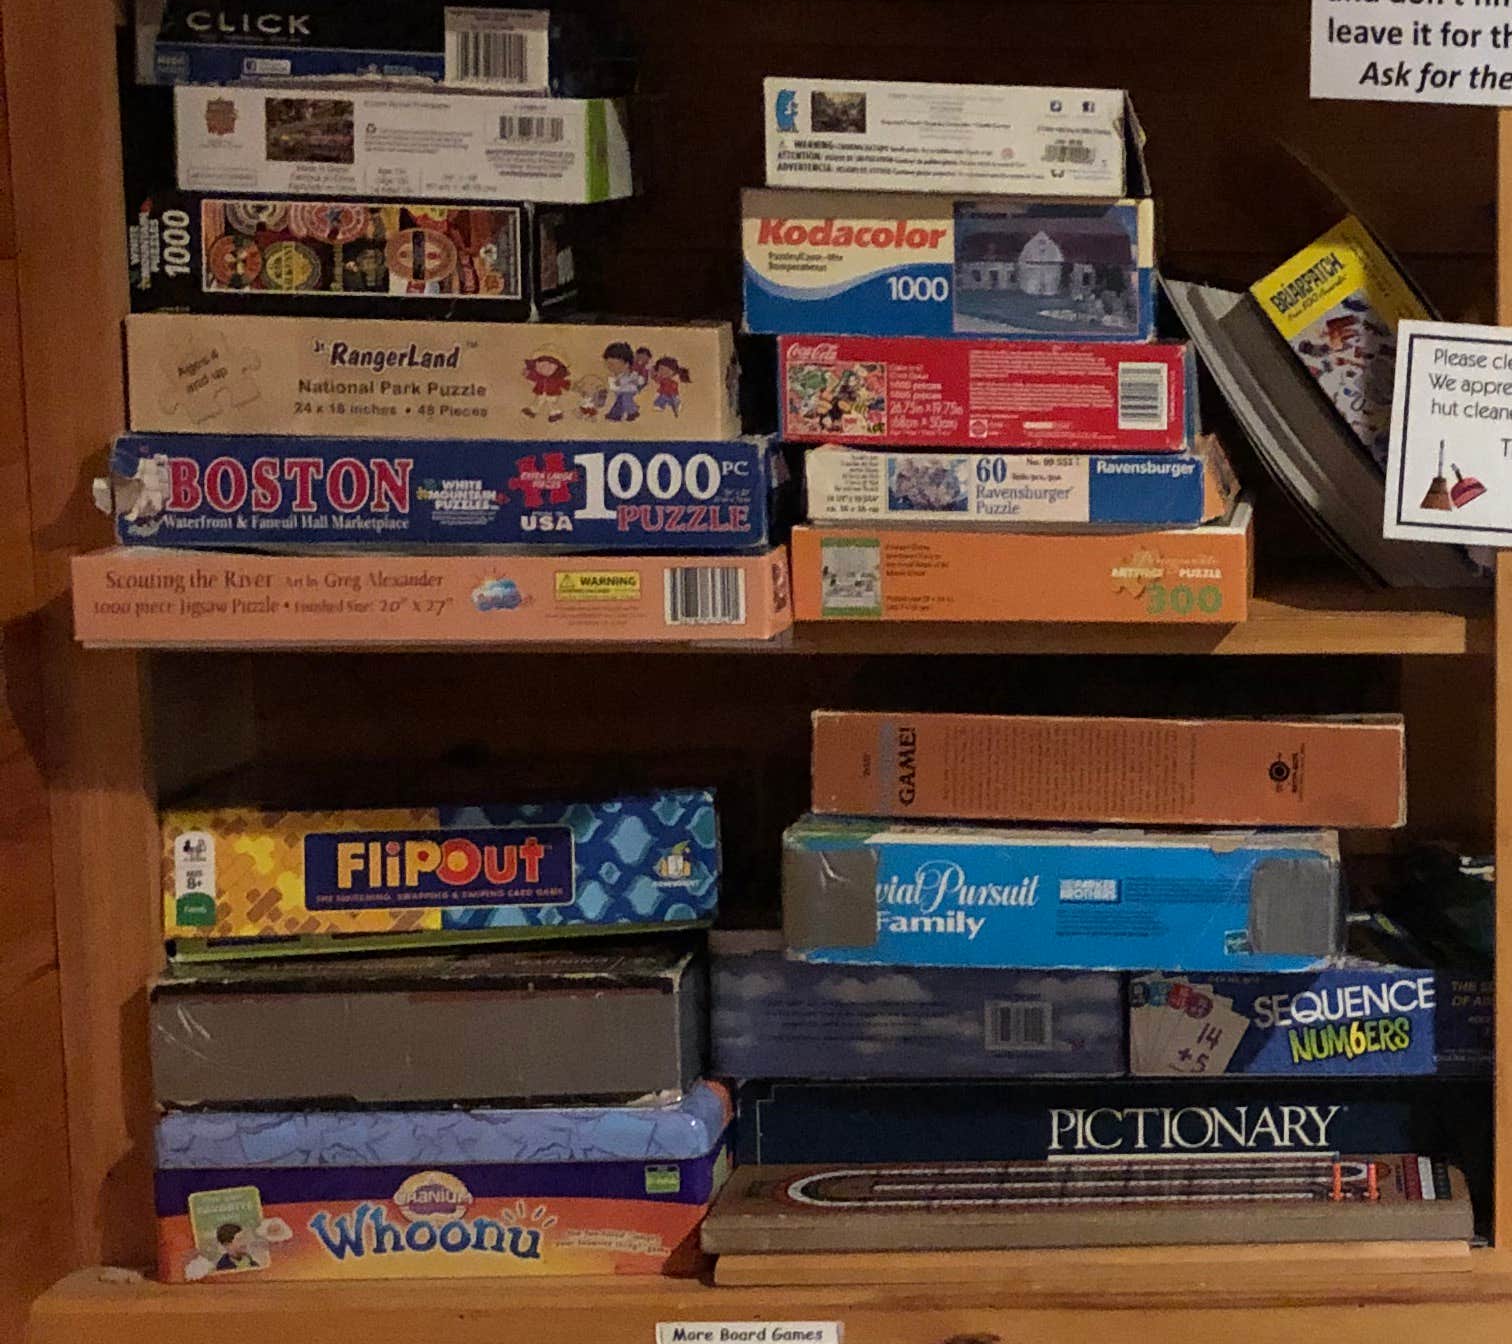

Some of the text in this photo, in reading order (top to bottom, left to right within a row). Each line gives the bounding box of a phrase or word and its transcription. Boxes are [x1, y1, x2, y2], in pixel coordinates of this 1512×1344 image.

[185, 10, 312, 35] CLICK
[1327, 19, 1404, 45] leave
[1412, 21, 1432, 46] it
[1439, 21, 1483, 47] for
[1358, 61, 1411, 87] Ask
[1414, 62, 1462, 93] for
[162, 209, 191, 277] 1000
[757, 216, 948, 250] Kodacolor
[887, 275, 949, 301] 1000
[330, 342, 462, 373] RangerLand
[1433, 348, 1488, 370] Please
[298, 379, 488, 397] National Park Puzzle
[1429, 372, 1458, 393] We
[1430, 399, 1460, 417] hut
[975, 457, 1007, 484] 60
[1096, 460, 1198, 479] Ravensburger
[166, 456, 414, 514] BOSTON
[440, 479, 483, 491] WHITE
[573, 452, 750, 521] 1000 PC
[975, 484, 1074, 503] Ravensburger
[616, 505, 752, 533] PUZZLE
[975, 502, 1021, 515] Puzzle
[520, 515, 574, 532] USA
[579, 574, 639, 588] WARNING
[1178, 566, 1223, 580] PUZZLE
[1147, 582, 1224, 615] 300
[916, 859, 1041, 908] Pursuit
[1252, 977, 1438, 1030] SEQUENCE
[1048, 1105, 1344, 1152] PICTIONARY
[309, 1202, 543, 1260] Whoonu
[672, 1326, 824, 1343] More Board Games
